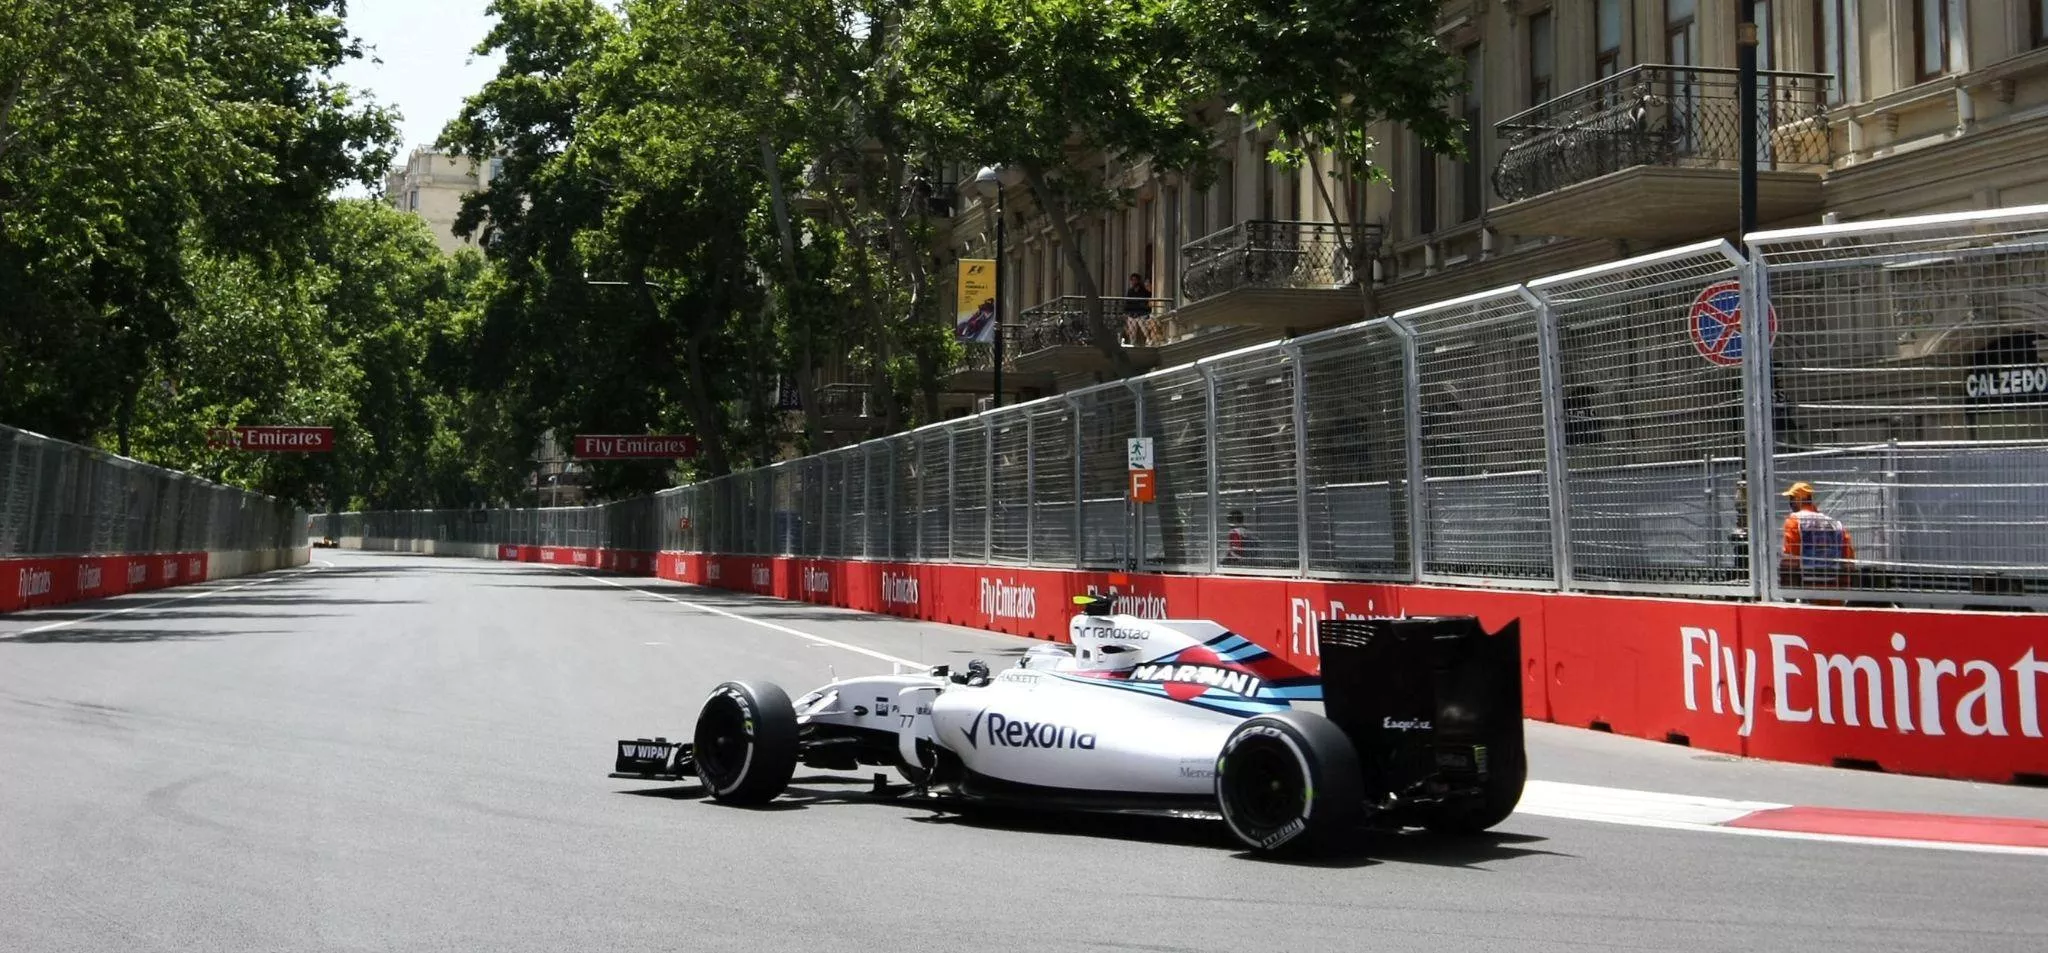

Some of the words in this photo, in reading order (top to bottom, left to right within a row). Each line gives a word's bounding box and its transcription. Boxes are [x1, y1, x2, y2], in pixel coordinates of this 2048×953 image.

[1966, 367, 2047, 398] CALZEDO
[247, 429, 323, 446] Emirates
[585, 438, 613, 456] Fly
[616, 437, 687, 454] Emirates
[1133, 473, 1149, 498] F
[980, 577, 996, 623] Fly
[996, 577, 1036, 620] Emirates
[1128, 664, 1260, 697] MARTINI
[1680, 626, 1757, 736] Fly
[900, 714, 915, 729] 77
[987, 712, 1097, 750] Rexona
